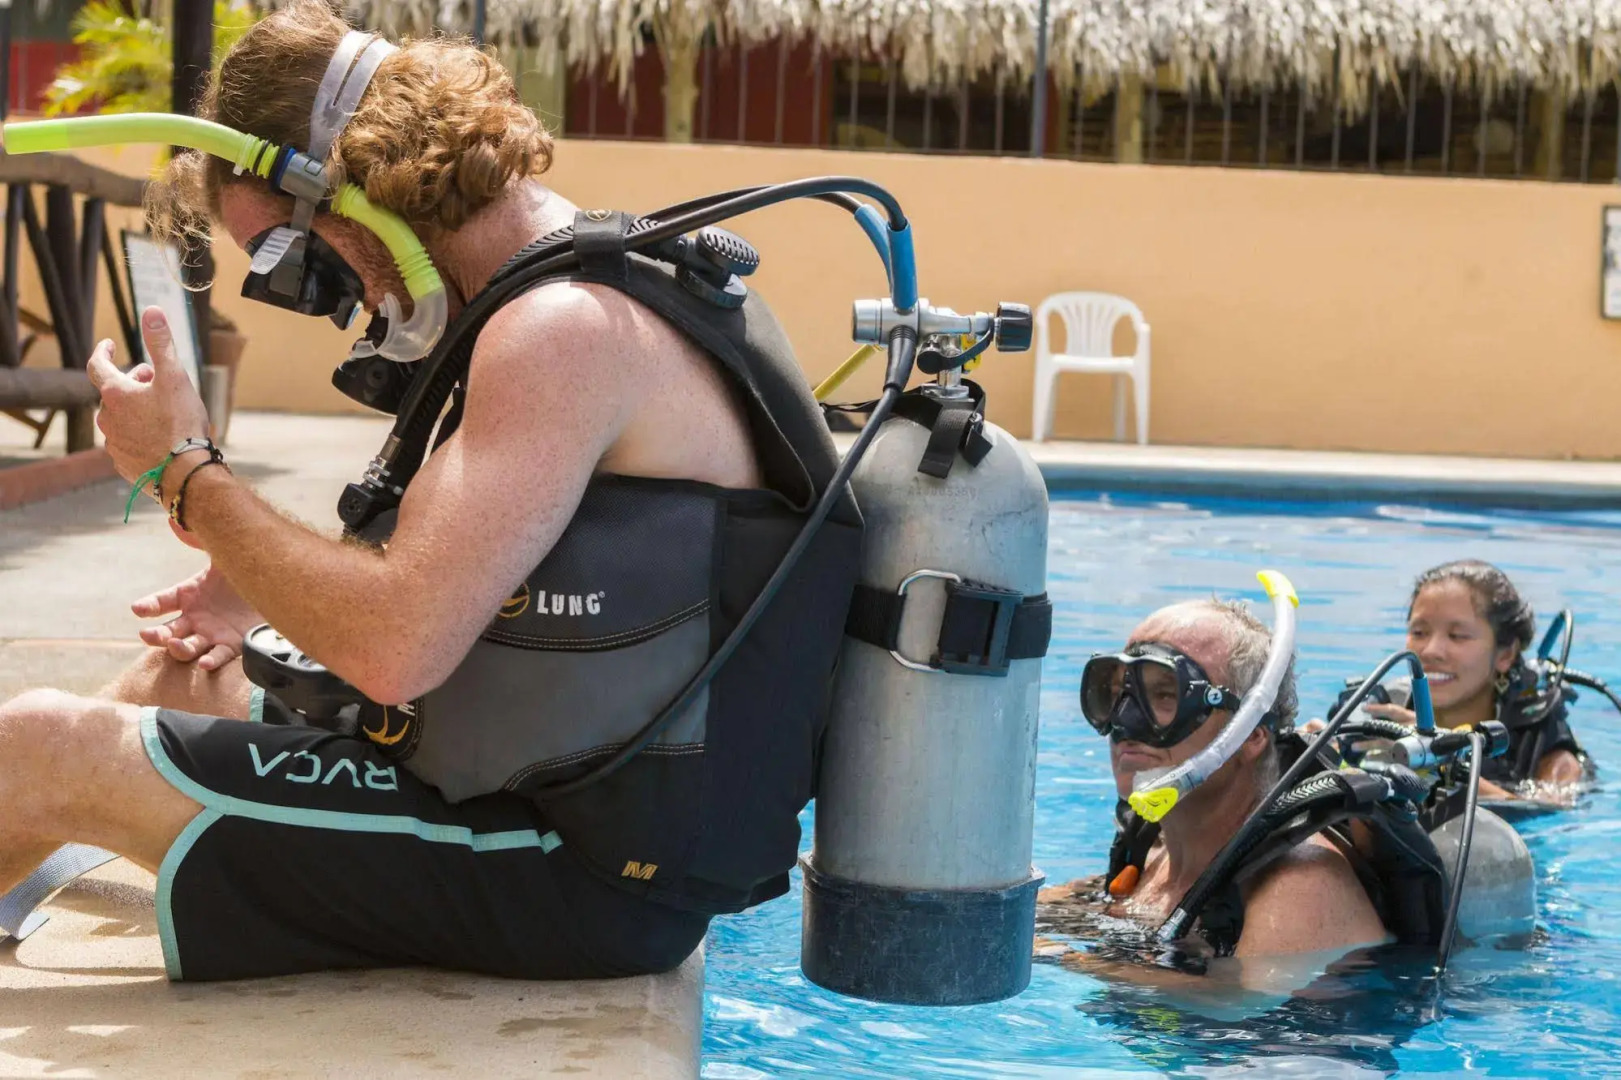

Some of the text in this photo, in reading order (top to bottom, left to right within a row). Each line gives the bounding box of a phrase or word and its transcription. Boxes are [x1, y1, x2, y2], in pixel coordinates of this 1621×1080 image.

[537, 590, 601, 616] LUNG
[248, 743, 398, 791] RVCA
[621, 861, 658, 880] M
